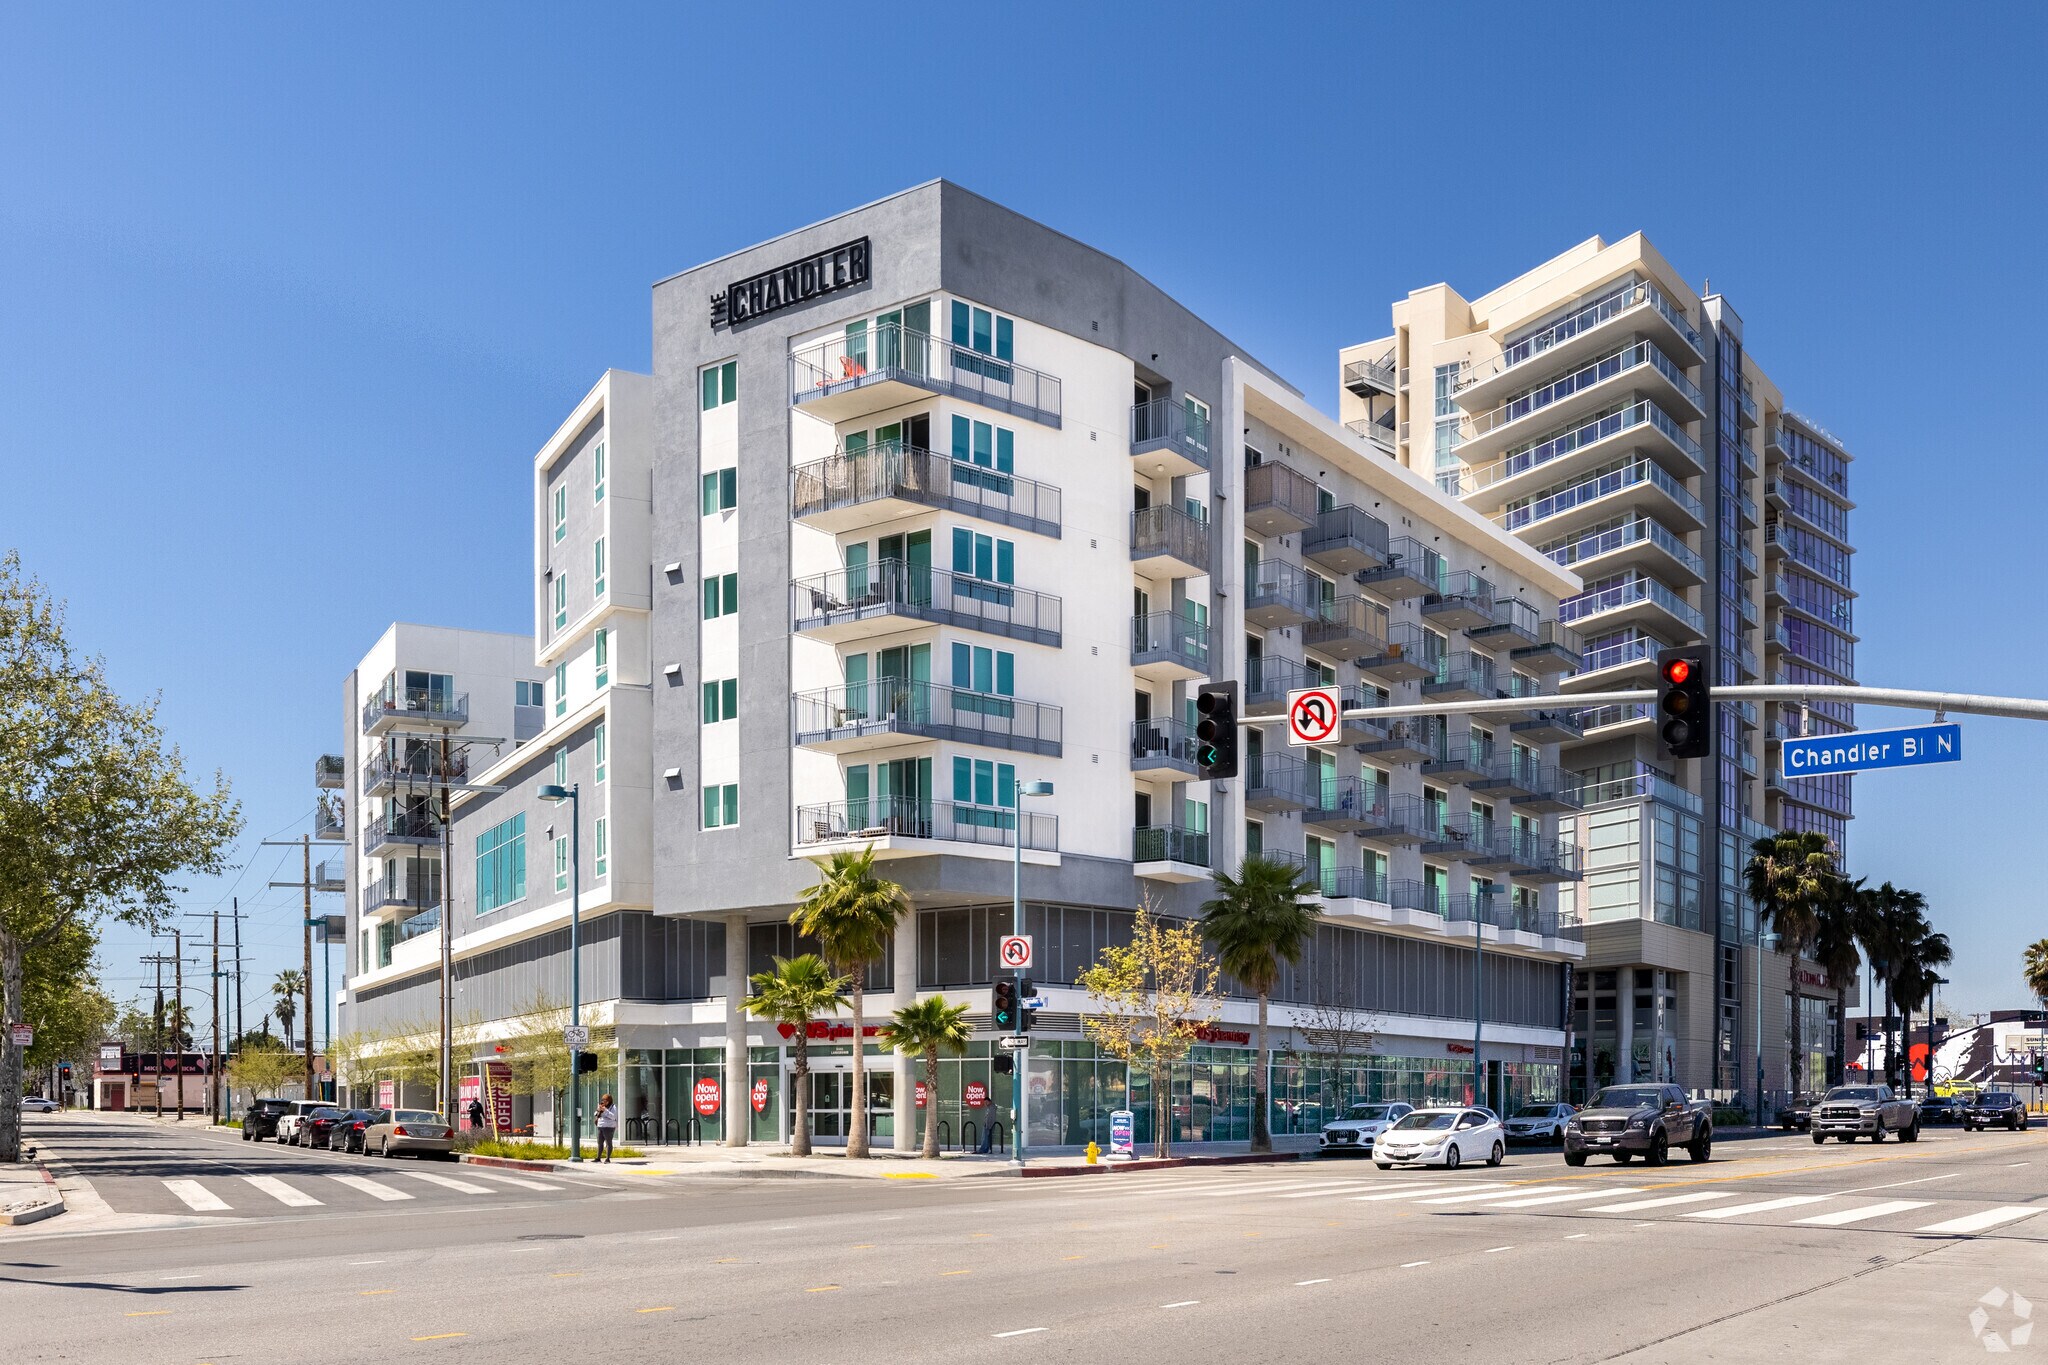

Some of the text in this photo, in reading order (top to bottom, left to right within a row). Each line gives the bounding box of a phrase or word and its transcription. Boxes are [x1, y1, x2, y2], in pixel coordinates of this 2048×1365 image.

[733, 245, 864, 319] CHANDLER
[711, 290, 728, 328] THE
[1791, 743, 1891, 768] Chandler
[1937, 733, 1952, 754] N
[697, 1083, 717, 1094] Now
[967, 1085, 984, 1094] Now
[695, 1092, 719, 1104] open!
[966, 1091, 986, 1101] open!
